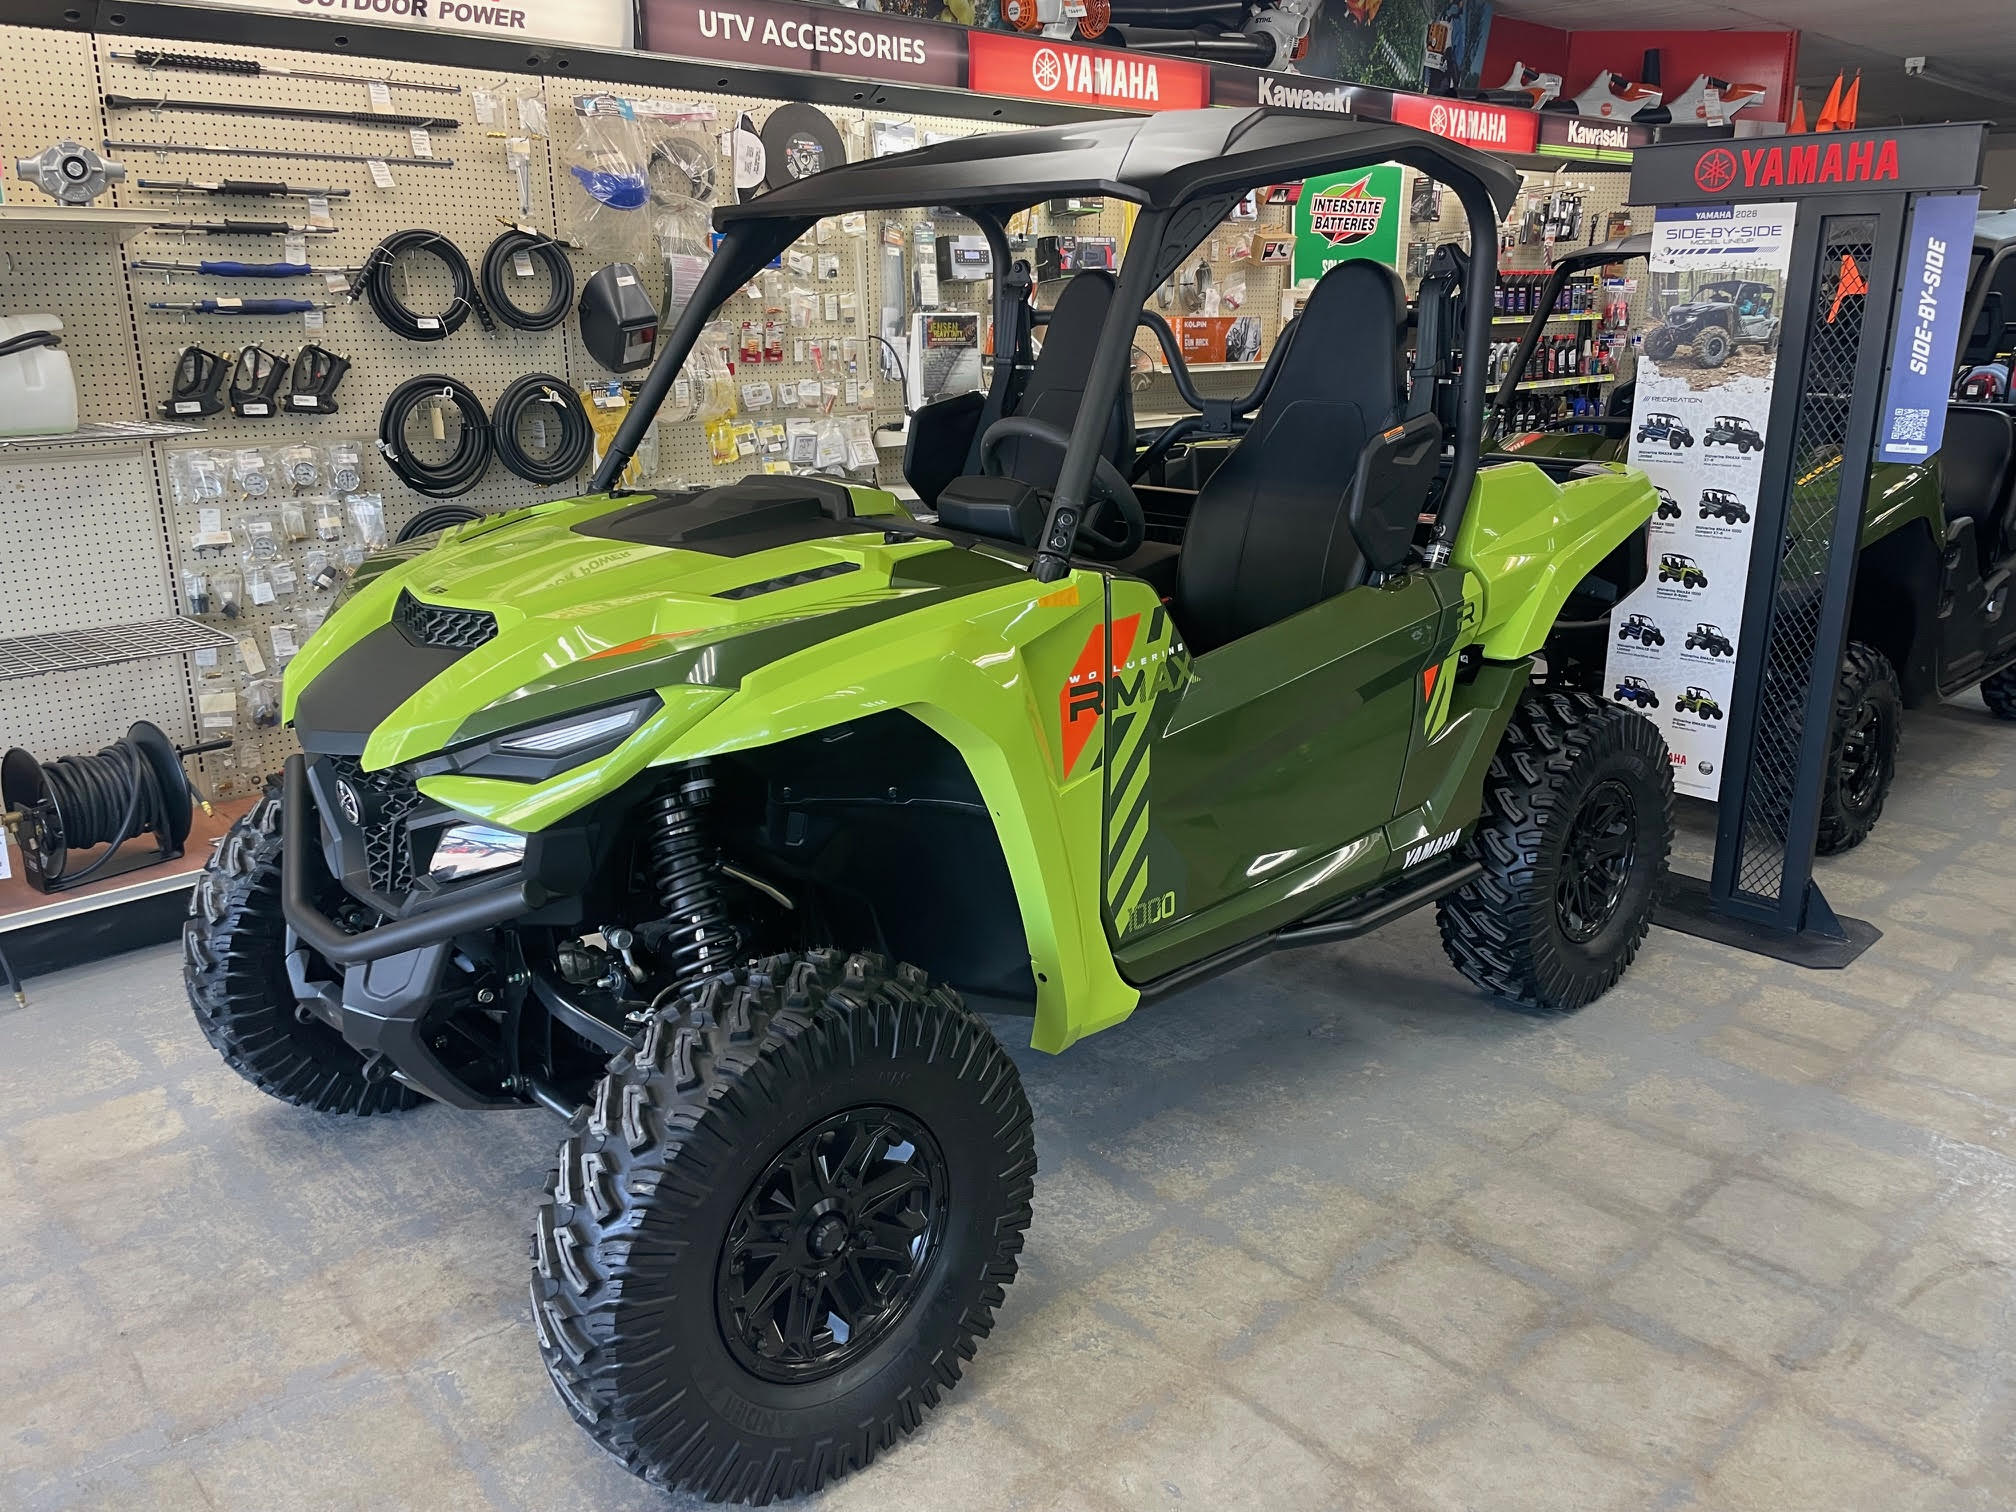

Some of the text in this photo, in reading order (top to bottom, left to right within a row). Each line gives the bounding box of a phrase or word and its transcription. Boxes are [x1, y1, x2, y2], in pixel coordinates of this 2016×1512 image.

[297, 0, 525, 29] DOOR POWER
[698, 9, 926, 65] UTV ACCESSORIES
[1063, 52, 1159, 101] YAMAHA
[1258, 76, 1351, 114] Kawasaki
[1448, 107, 1507, 143] YAMAHA
[1567, 120, 1628, 148] Kawasaki
[1742, 140, 1899, 187] YAMAHA
[1313, 198, 1381, 214] INTERSTATE
[1314, 216, 1375, 231] BATTERIES
[1695, 211, 1732, 220] YAMAHA
[1666, 225, 1782, 240] SIDE-BY-SIDE
[1723, 237, 1755, 245] LINEUP
[1910, 236, 1946, 376] SIDE-BY-SIDE
[1070, 653, 1198, 722] RMAX
[1402, 828, 1461, 869] YAMAHA
[1129, 891, 1175, 932] 1000
